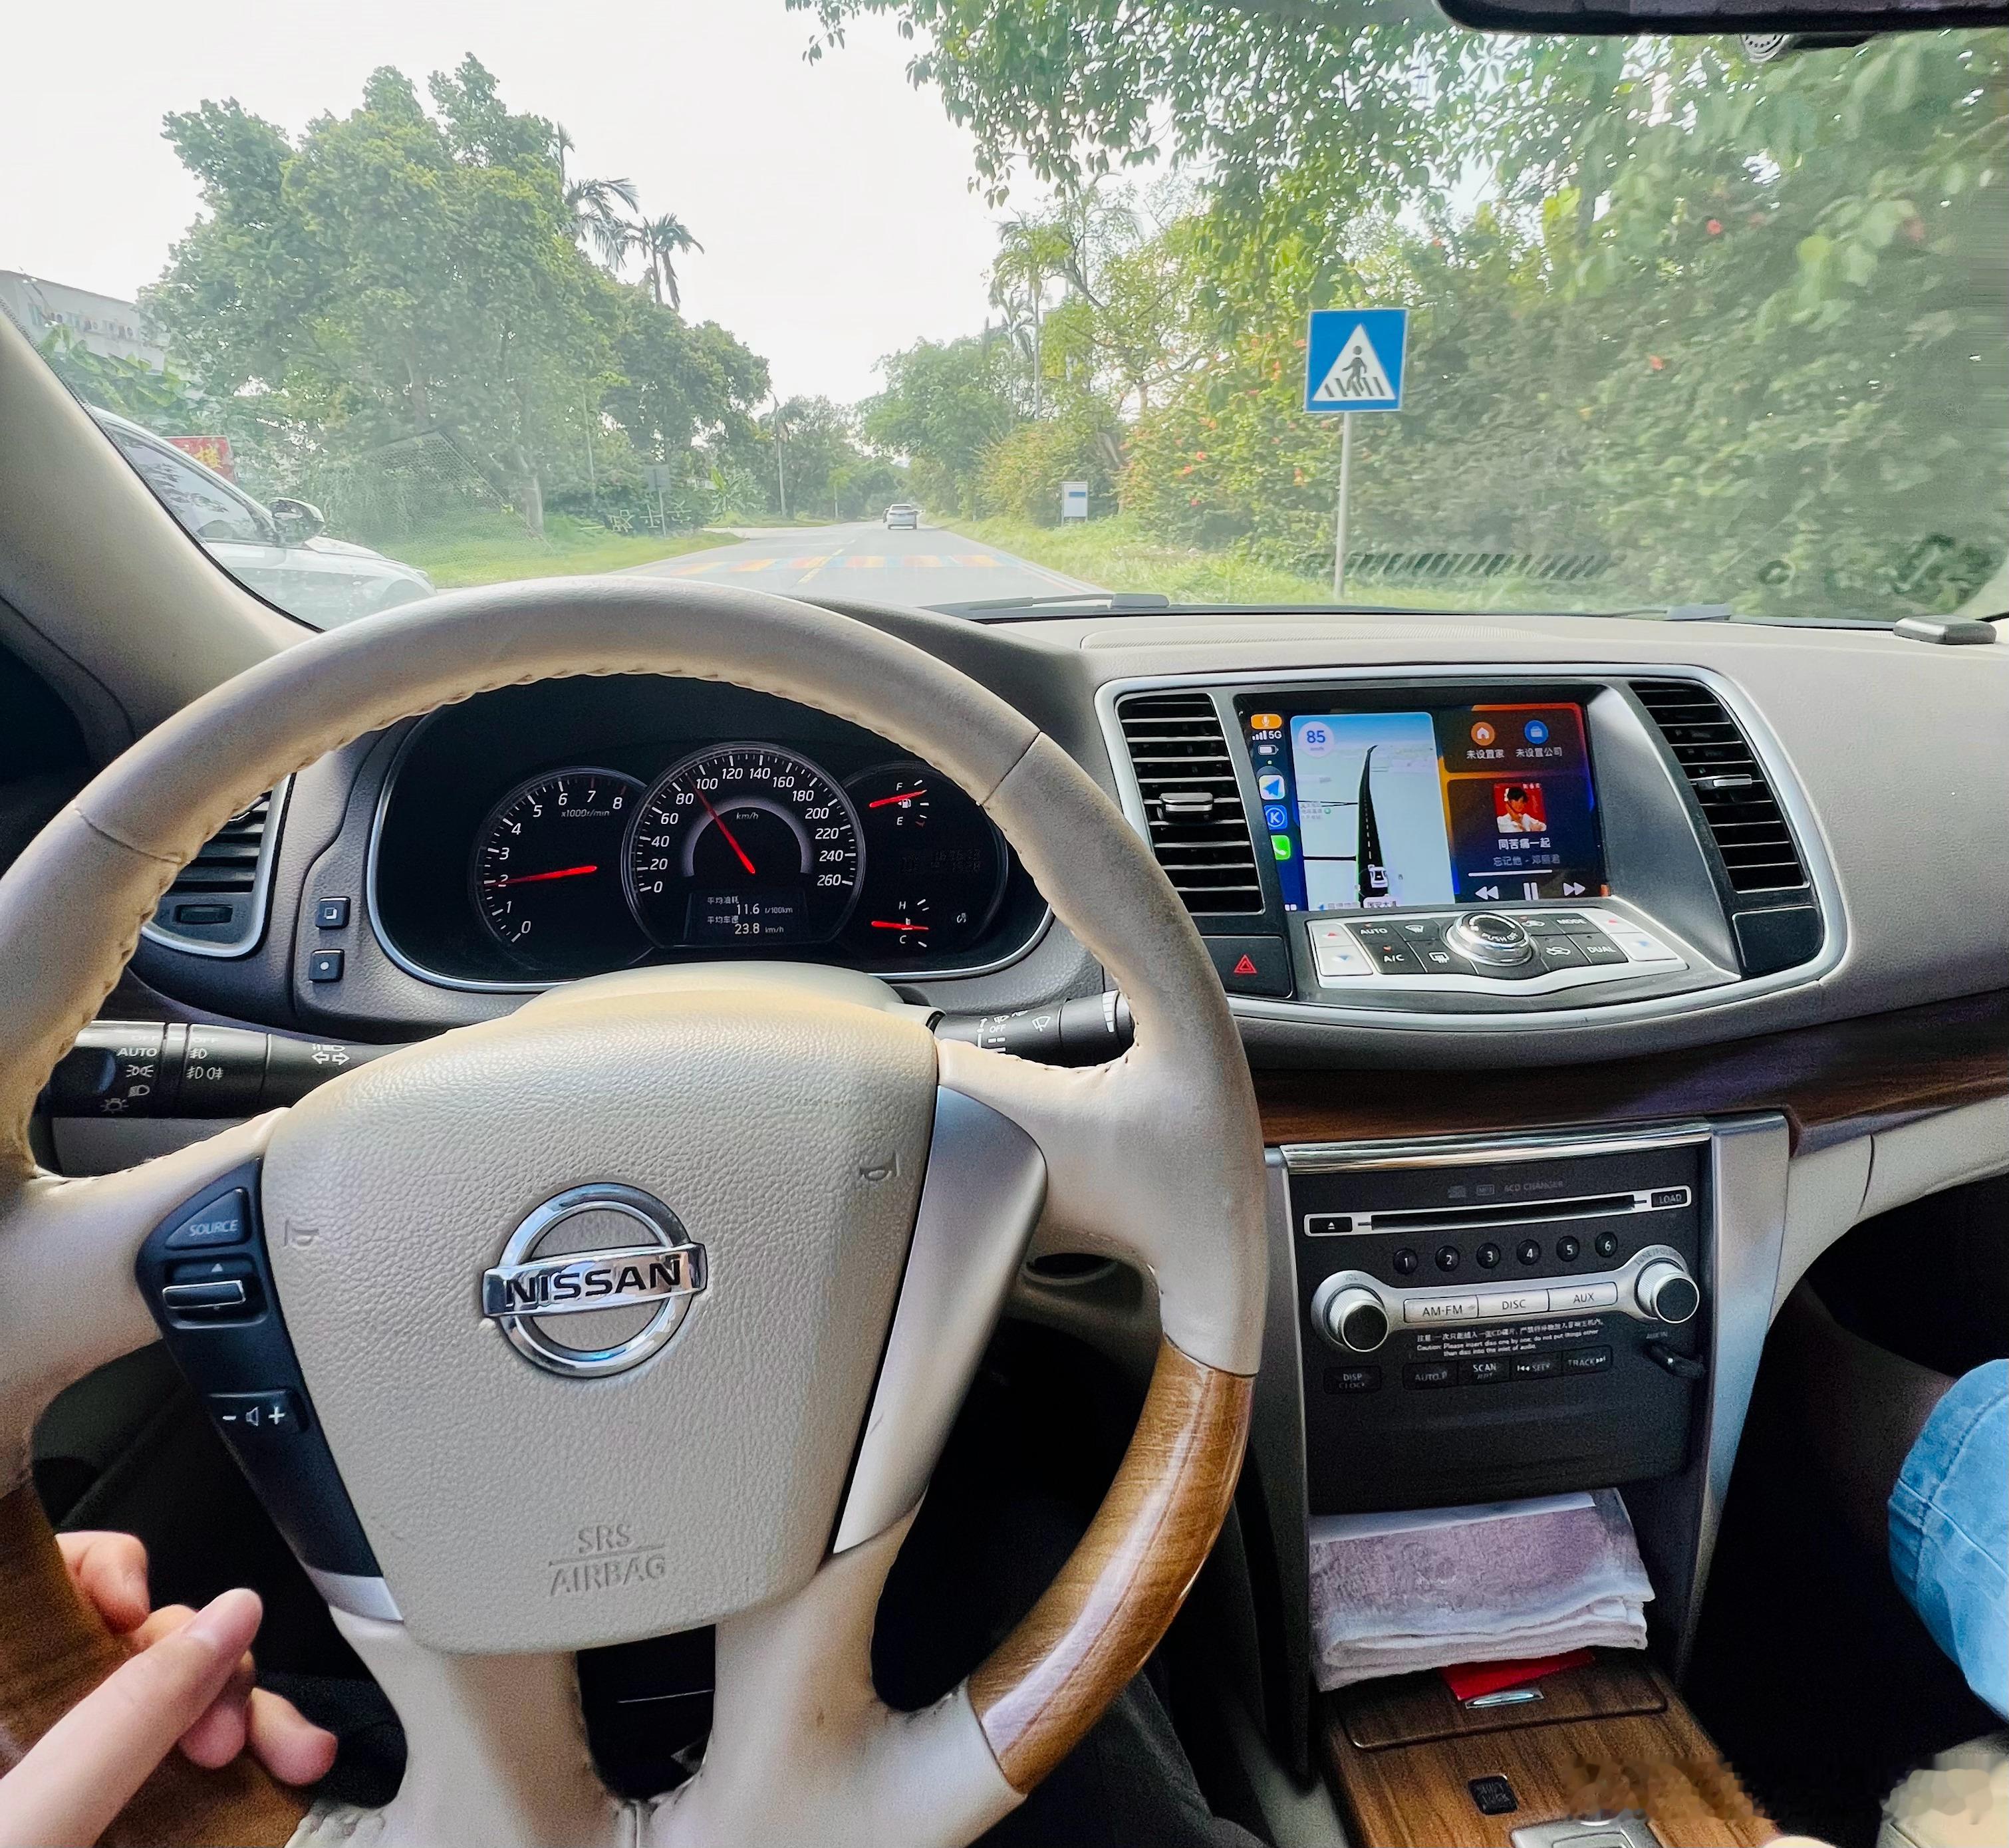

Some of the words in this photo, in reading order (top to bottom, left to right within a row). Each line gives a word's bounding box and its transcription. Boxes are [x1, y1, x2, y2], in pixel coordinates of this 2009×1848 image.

[1268, 730, 1282, 739] 5G
[1306, 729, 1325, 743] 85
[1516, 747, 1563, 758] 未设置公司
[722, 767, 743, 780] 120
[749, 767, 771, 779] 140
[696, 778, 718, 790] 100
[773, 776, 795, 788] 160
[896, 782, 903, 791] F
[558, 793, 568, 805] 6
[587, 790, 596, 803] 7
[676, 793, 694, 805] 80
[792, 790, 814, 802] 180
[612, 797, 622, 810] 8
[533, 805, 543, 817] 5
[736, 811, 759, 821] km/h
[805, 807, 829, 819] 200
[660, 813, 678, 825] 60
[896, 817, 903, 825] E
[511, 823, 521, 835] 4
[815, 827, 839, 839] 220
[651, 835, 670, 847] 40
[499, 847, 510, 860] 3
[819, 850, 843, 862] 240
[650, 858, 668, 870] 20
[498, 874, 509, 887] 2
[817, 874, 841, 886] 260
[653, 881, 663, 892] 0
[506, 900, 512, 913] 1
[736, 903, 760, 915] 11.6
[898, 901, 906, 910] H
[521, 920, 531, 933] 0
[734, 923, 760, 934] 23.8
[900, 935, 907, 944] C
[1482, 932, 1507, 942] PUSH
[1383, 954, 1405, 962] A/C
[989, 1024, 1006, 1033] OFF
[116, 1047, 158, 1058] AUTO
[1659, 1194, 1682, 1204] LOAD
[189, 1219, 239, 1237] SOURCE
[1566, 1244, 1573, 1255] 5
[1605, 1241, 1611, 1252] 6
[1487, 1251, 1494, 1261] 3
[1526, 1248, 1533, 1258] 4
[1405, 1257, 1409, 1267] 1
[1446, 1255, 1452, 1265] 2
[505, 1252, 682, 1307] NISSAN
[1573, 1292, 1595, 1304] AUX
[1502, 1299, 1526, 1311] DISC
[1473, 1363, 1497, 1373] SCAN
[1343, 1373, 1363, 1381] DISP
[577, 1523, 631, 1555] SRS
[549, 1555, 667, 1597] AIRBAG
